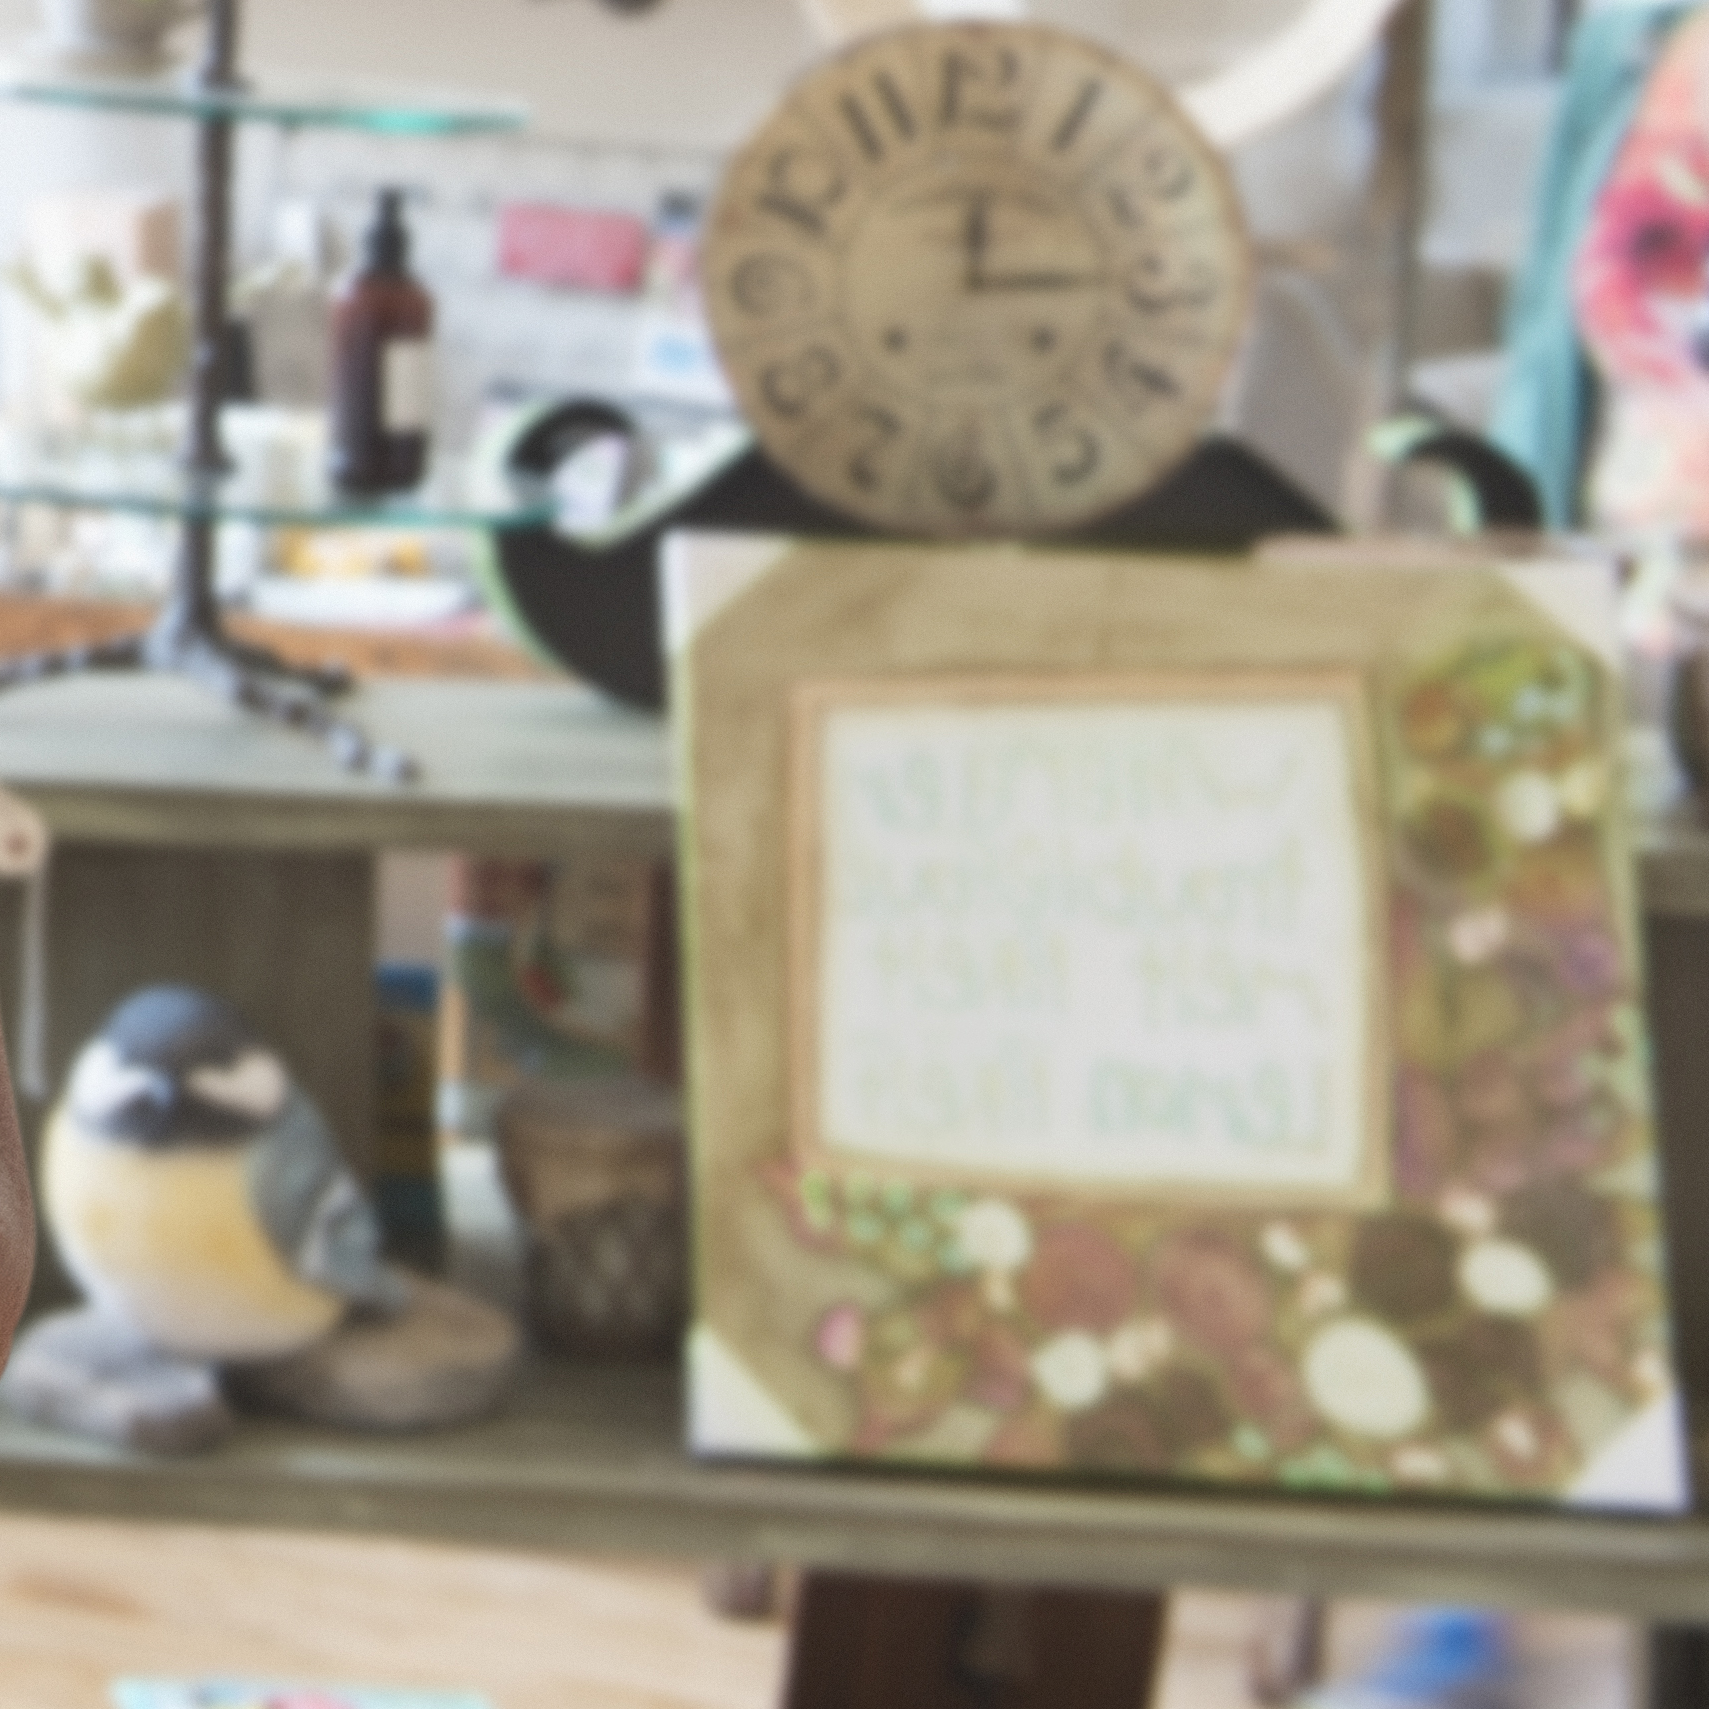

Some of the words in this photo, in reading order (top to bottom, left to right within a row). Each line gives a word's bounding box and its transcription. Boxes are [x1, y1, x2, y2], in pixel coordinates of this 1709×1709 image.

[834, 67, 920, 165] 11
[936, 47, 1022, 132] 12
[752, 142, 850, 240] 10
